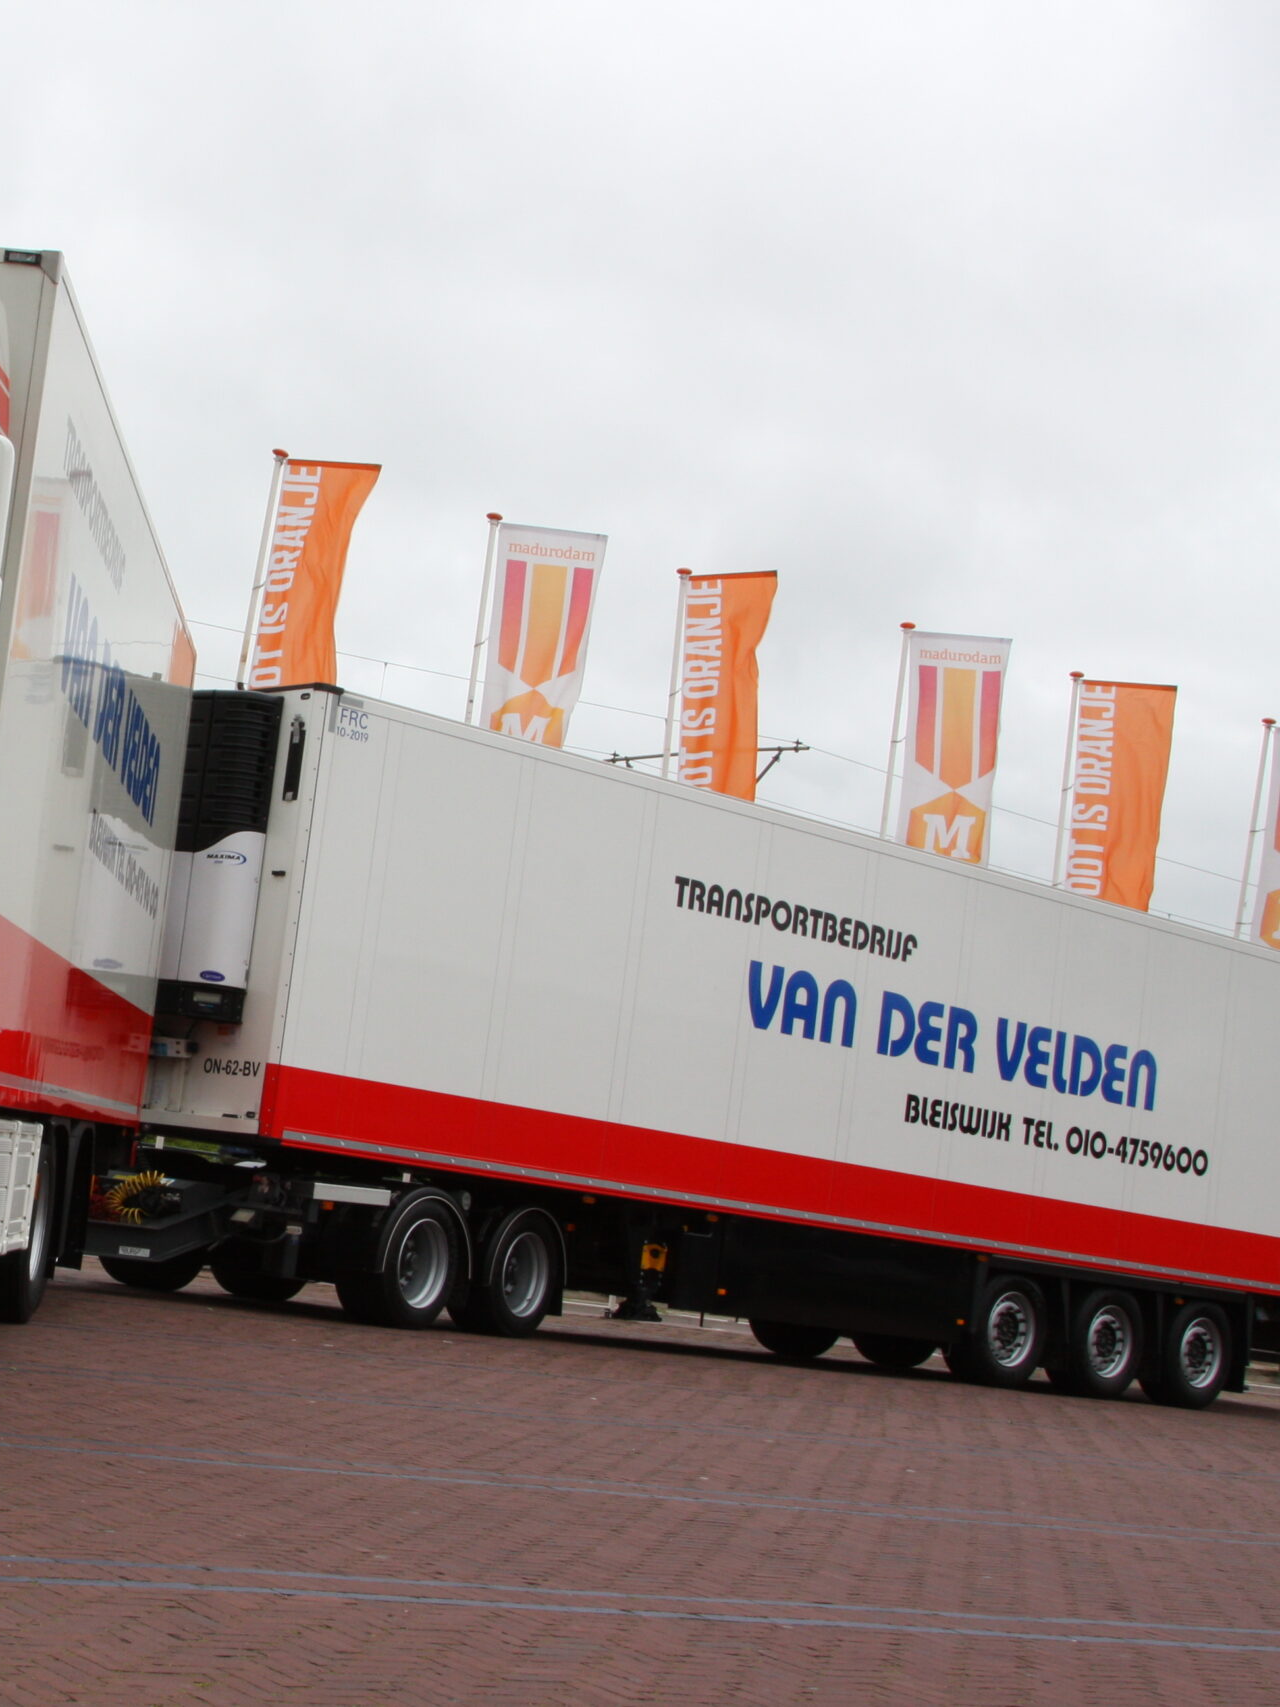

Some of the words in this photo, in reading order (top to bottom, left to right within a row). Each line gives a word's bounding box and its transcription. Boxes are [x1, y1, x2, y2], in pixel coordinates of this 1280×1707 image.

[266, 464, 322, 592] ORANJE
[508, 543, 596, 561] madurodam
[257, 602, 288, 634] IS
[682, 579, 723, 699] ORANJE
[920, 648, 1003, 665] madurodam
[93, 638, 126, 772] DER
[121, 688, 161, 828] VELDEN
[336, 726, 369, 743] 10-2019
[340, 707, 369, 729] FRC
[681, 706, 717, 736] IS
[1075, 684, 1117, 795] ORANJE
[679, 747, 715, 791] OT
[923, 813, 977, 859] M
[1071, 803, 1109, 831] IS
[674, 875, 919, 962] TRANSPORTBEDRIJF
[748, 959, 858, 1049] VAN
[877, 990, 979, 1074] DER
[996, 1016, 1158, 1111] VELDEN
[204, 1057, 261, 1077] ON-62-BV
[904, 1093, 1012, 1142] BLEISWIJK
[1022, 1116, 1059, 1152] TEL.
[1065, 1126, 1209, 1177] 010-4759600
